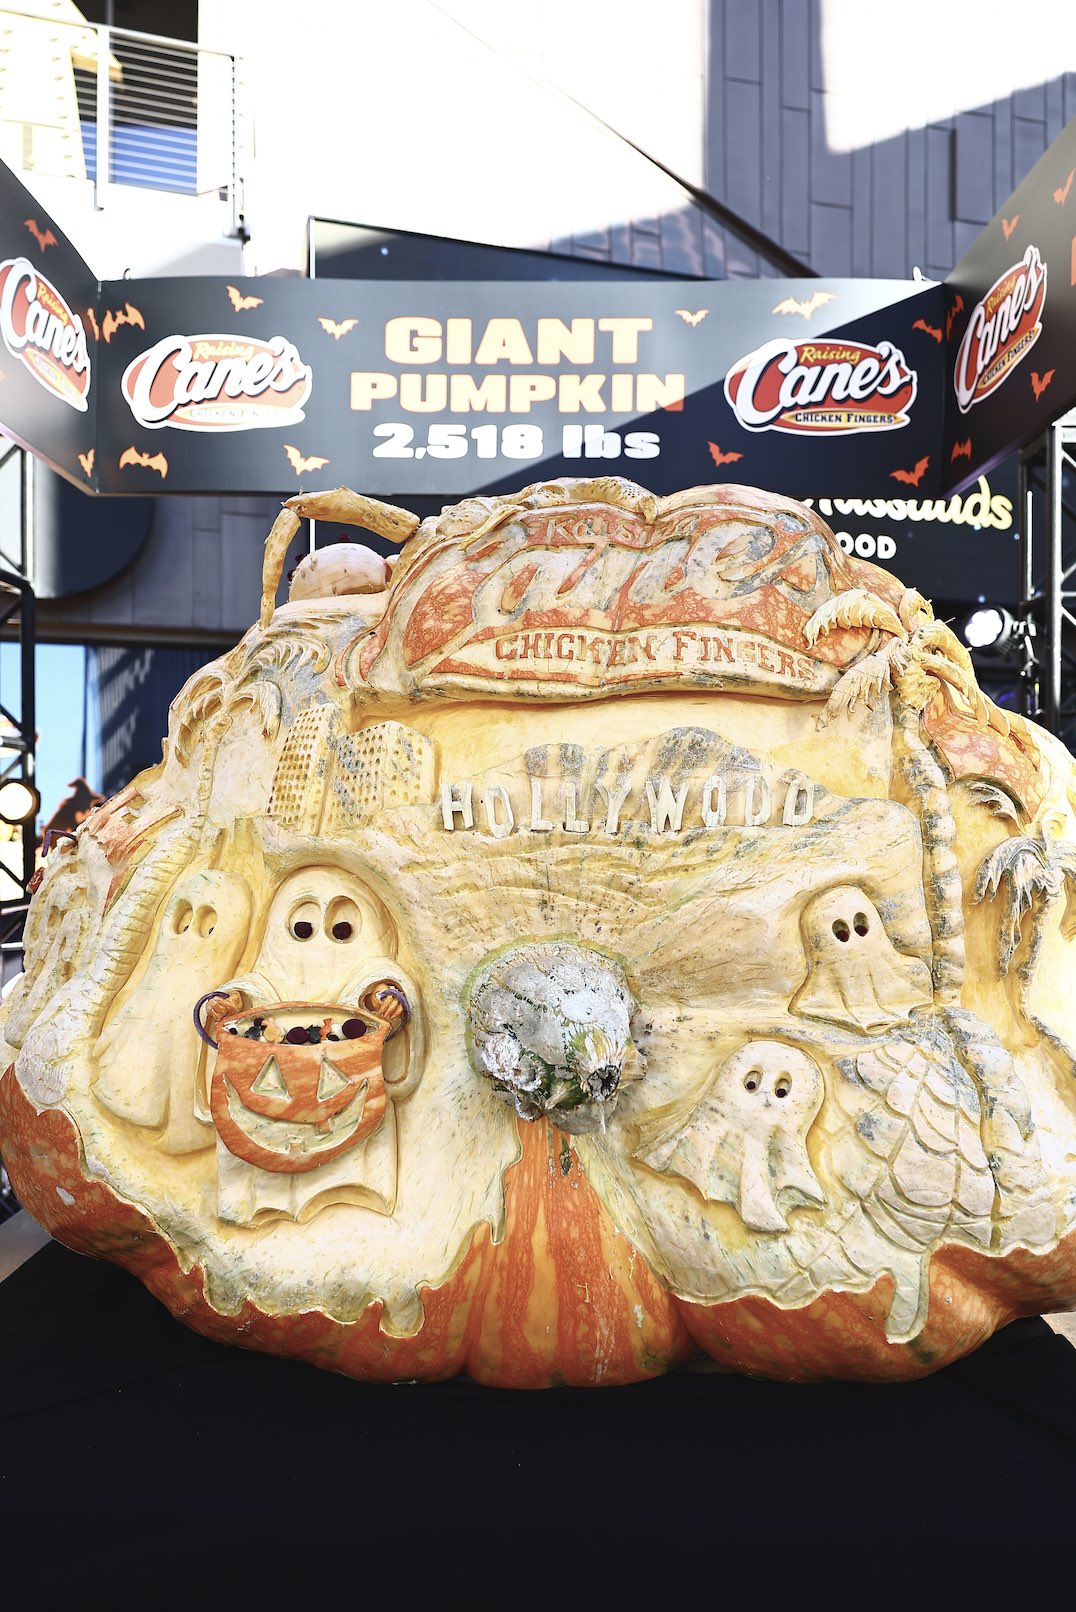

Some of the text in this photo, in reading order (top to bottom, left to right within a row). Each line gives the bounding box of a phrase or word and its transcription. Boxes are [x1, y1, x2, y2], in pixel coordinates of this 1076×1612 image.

[2, 259, 88, 373] Cane's
[385, 316, 653, 365] GIANT
[959, 248, 1046, 405] Cane's
[193, 342, 255, 361] Raising
[801, 346, 861, 364] Raising
[131, 336, 306, 422] Cane's
[350, 371, 685, 413] PUMPKIN
[735, 341, 911, 424] Cane's
[372, 422, 660, 460] 2,518 lbs
[794, 412, 894, 424] CHICKEN FINGERS
[494, 630, 816, 680] CHICKEN FINGERS
[441, 775, 815, 838] HOLLYWOOD
